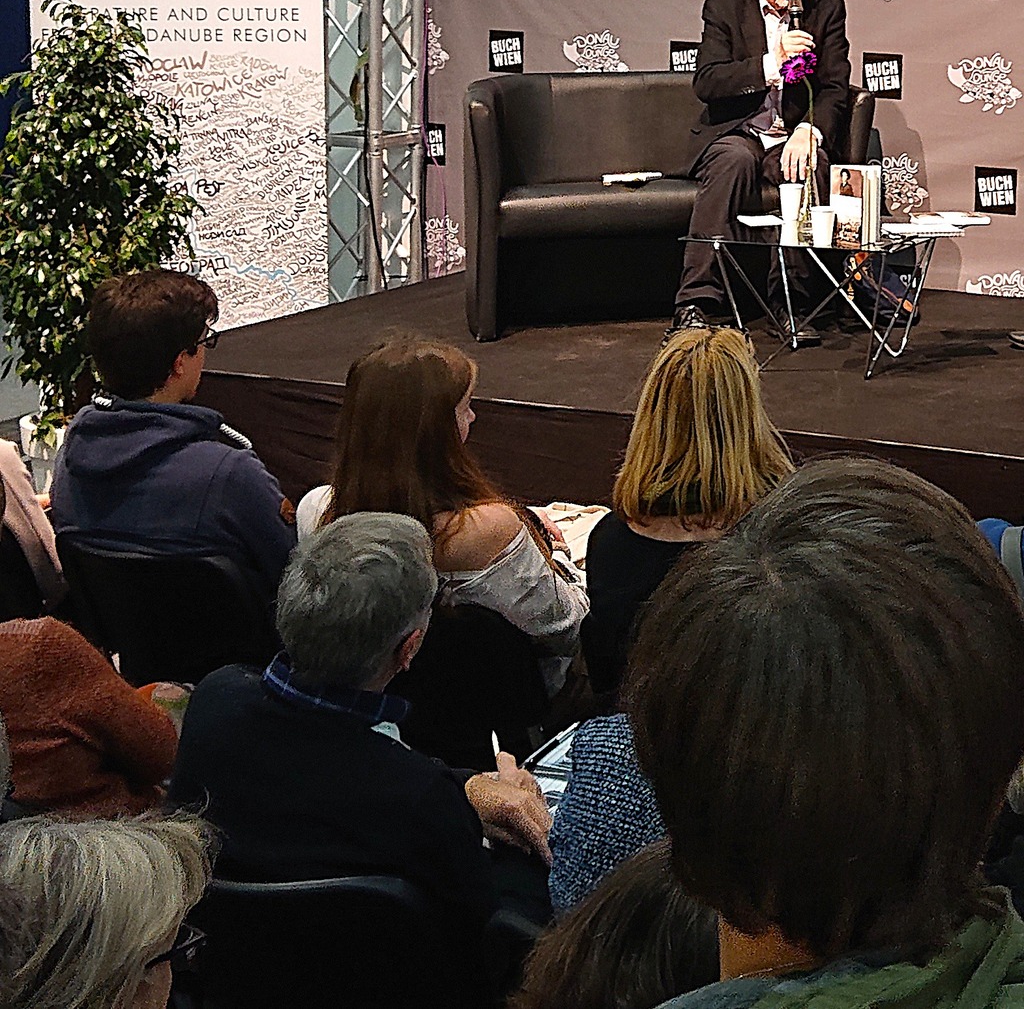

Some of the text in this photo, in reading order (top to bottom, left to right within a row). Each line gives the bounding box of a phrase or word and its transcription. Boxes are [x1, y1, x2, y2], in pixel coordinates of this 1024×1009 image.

[167, 8, 208, 22] AND
[217, 7, 300, 21] CULTURE
[146, 28, 307, 42] DANUBE REGION
[574, 29, 620, 48] DONAU
[491, 37, 521, 53] BUCH
[493, 51, 522, 66] WIEN
[672, 50, 698, 65] BUC
[958, 52, 1013, 73] DONAU
[865, 60, 899, 78] BUCH
[175, 69, 252, 98] KATOWICE
[866, 75, 900, 92] WIEN
[882, 152, 918, 173] ONAU
[978, 175, 1013, 193] BUCH
[979, 190, 1015, 208] WIEN
